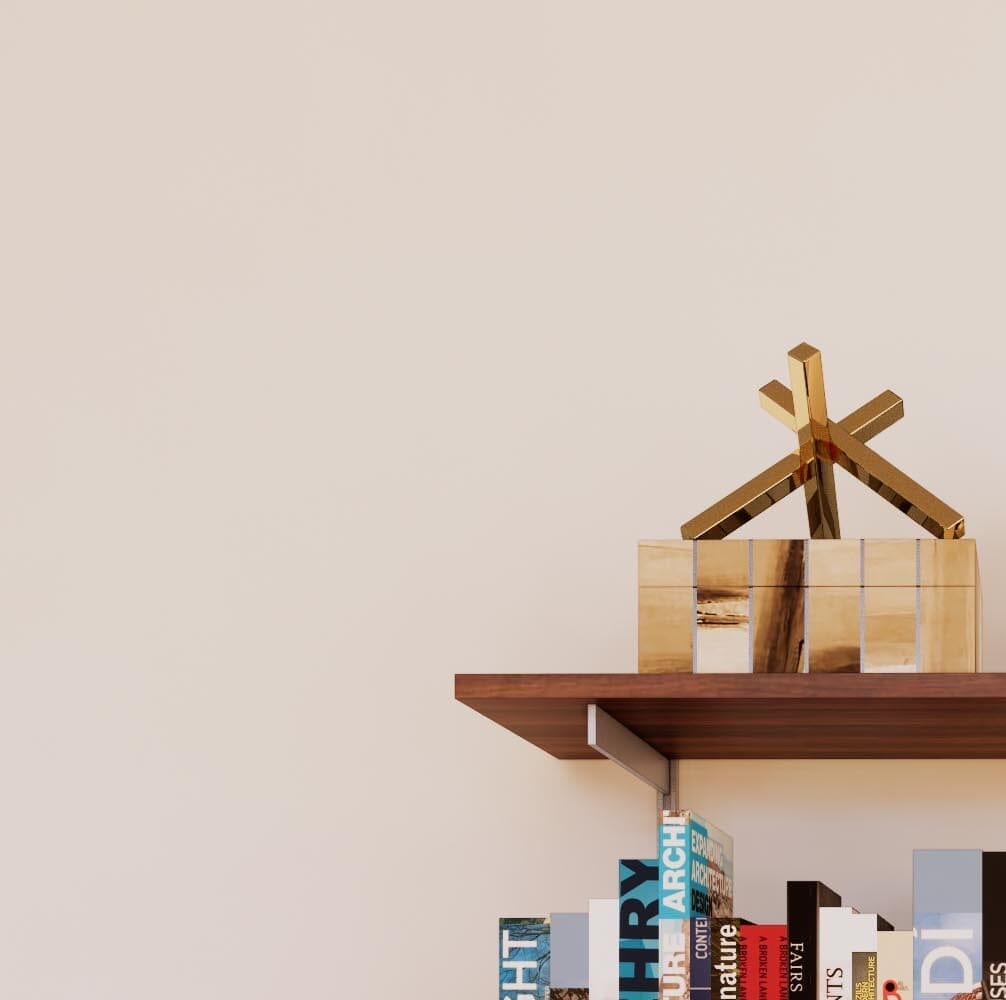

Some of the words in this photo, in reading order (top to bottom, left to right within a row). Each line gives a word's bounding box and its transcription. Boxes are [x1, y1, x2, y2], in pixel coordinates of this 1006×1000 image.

[695, 917, 708, 960] CONTE
[758, 944, 768, 979] BROKEN
[778, 944, 788, 979] BROKEN
[790, 943, 803, 993] FAIRS
